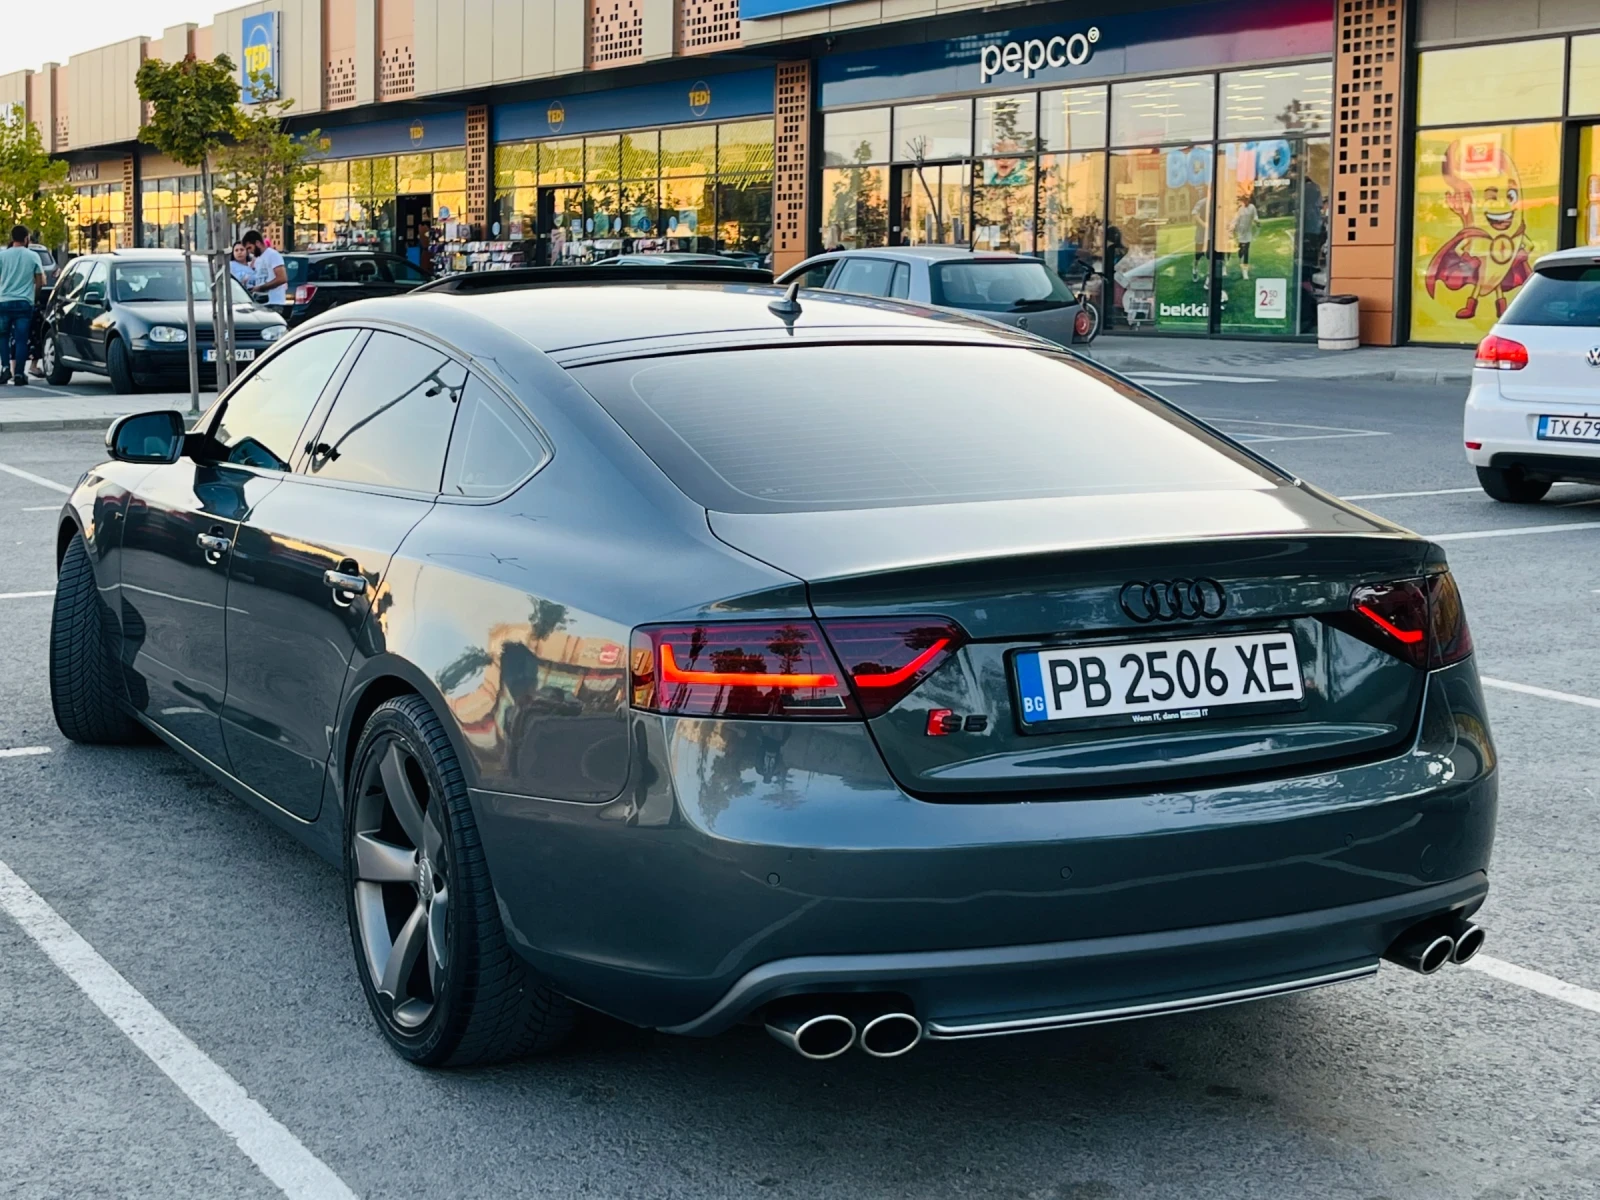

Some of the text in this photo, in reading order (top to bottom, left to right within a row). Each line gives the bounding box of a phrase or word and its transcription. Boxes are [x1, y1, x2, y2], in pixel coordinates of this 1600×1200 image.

[245, 43, 271, 73] TEDi
[981, 33, 1088, 84] pepco
[689, 90, 711, 107] TEDi
[547, 109, 564, 123] TEDi
[1551, 419, 1570, 435] TX
[1048, 642, 1294, 710] PB 2506 XE
[1023, 697, 1044, 713] BG
[1132, 714, 1152, 722] Wenn
[1162, 712, 1179, 720] dann
